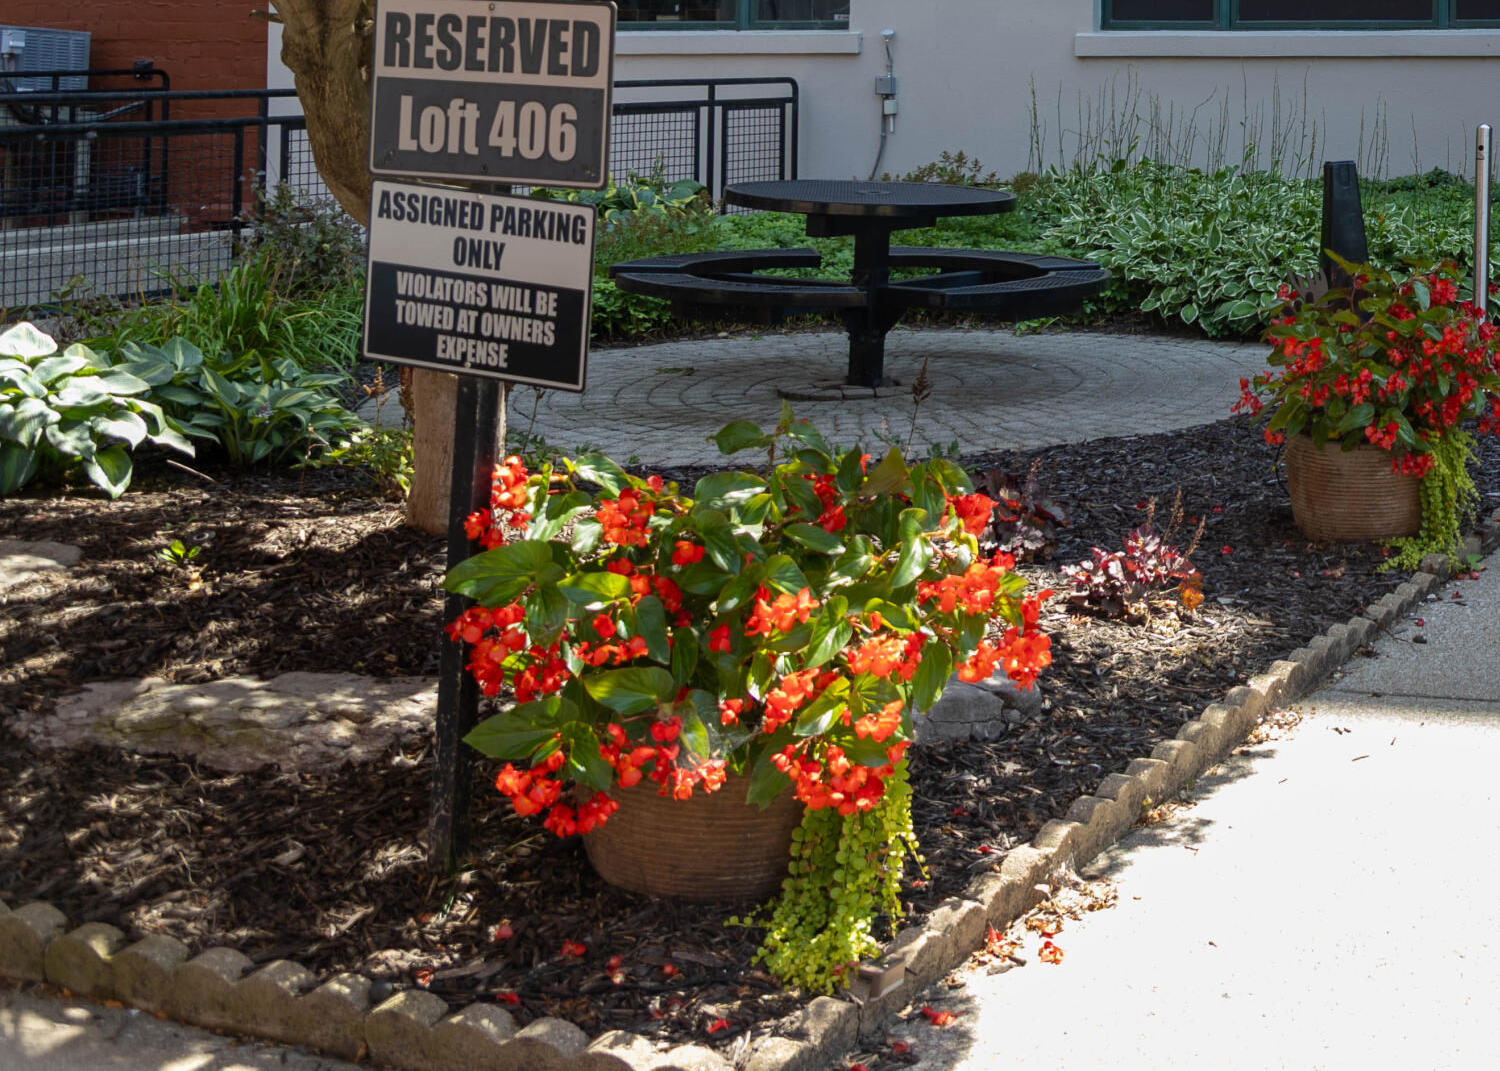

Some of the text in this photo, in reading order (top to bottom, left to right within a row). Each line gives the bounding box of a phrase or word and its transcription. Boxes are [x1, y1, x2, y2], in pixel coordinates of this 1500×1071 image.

[383, 11, 601, 78] RESERVED
[398, 95, 578, 162] Loft 406
[378, 189, 587, 245] ASSIGNED PARKING
[452, 235, 506, 272] ONLY
[395, 270, 558, 318] VIOLATORS WILL BE
[395, 298, 556, 347] TOWED AT OWNERS
[436, 333, 509, 369] EXPENSE
